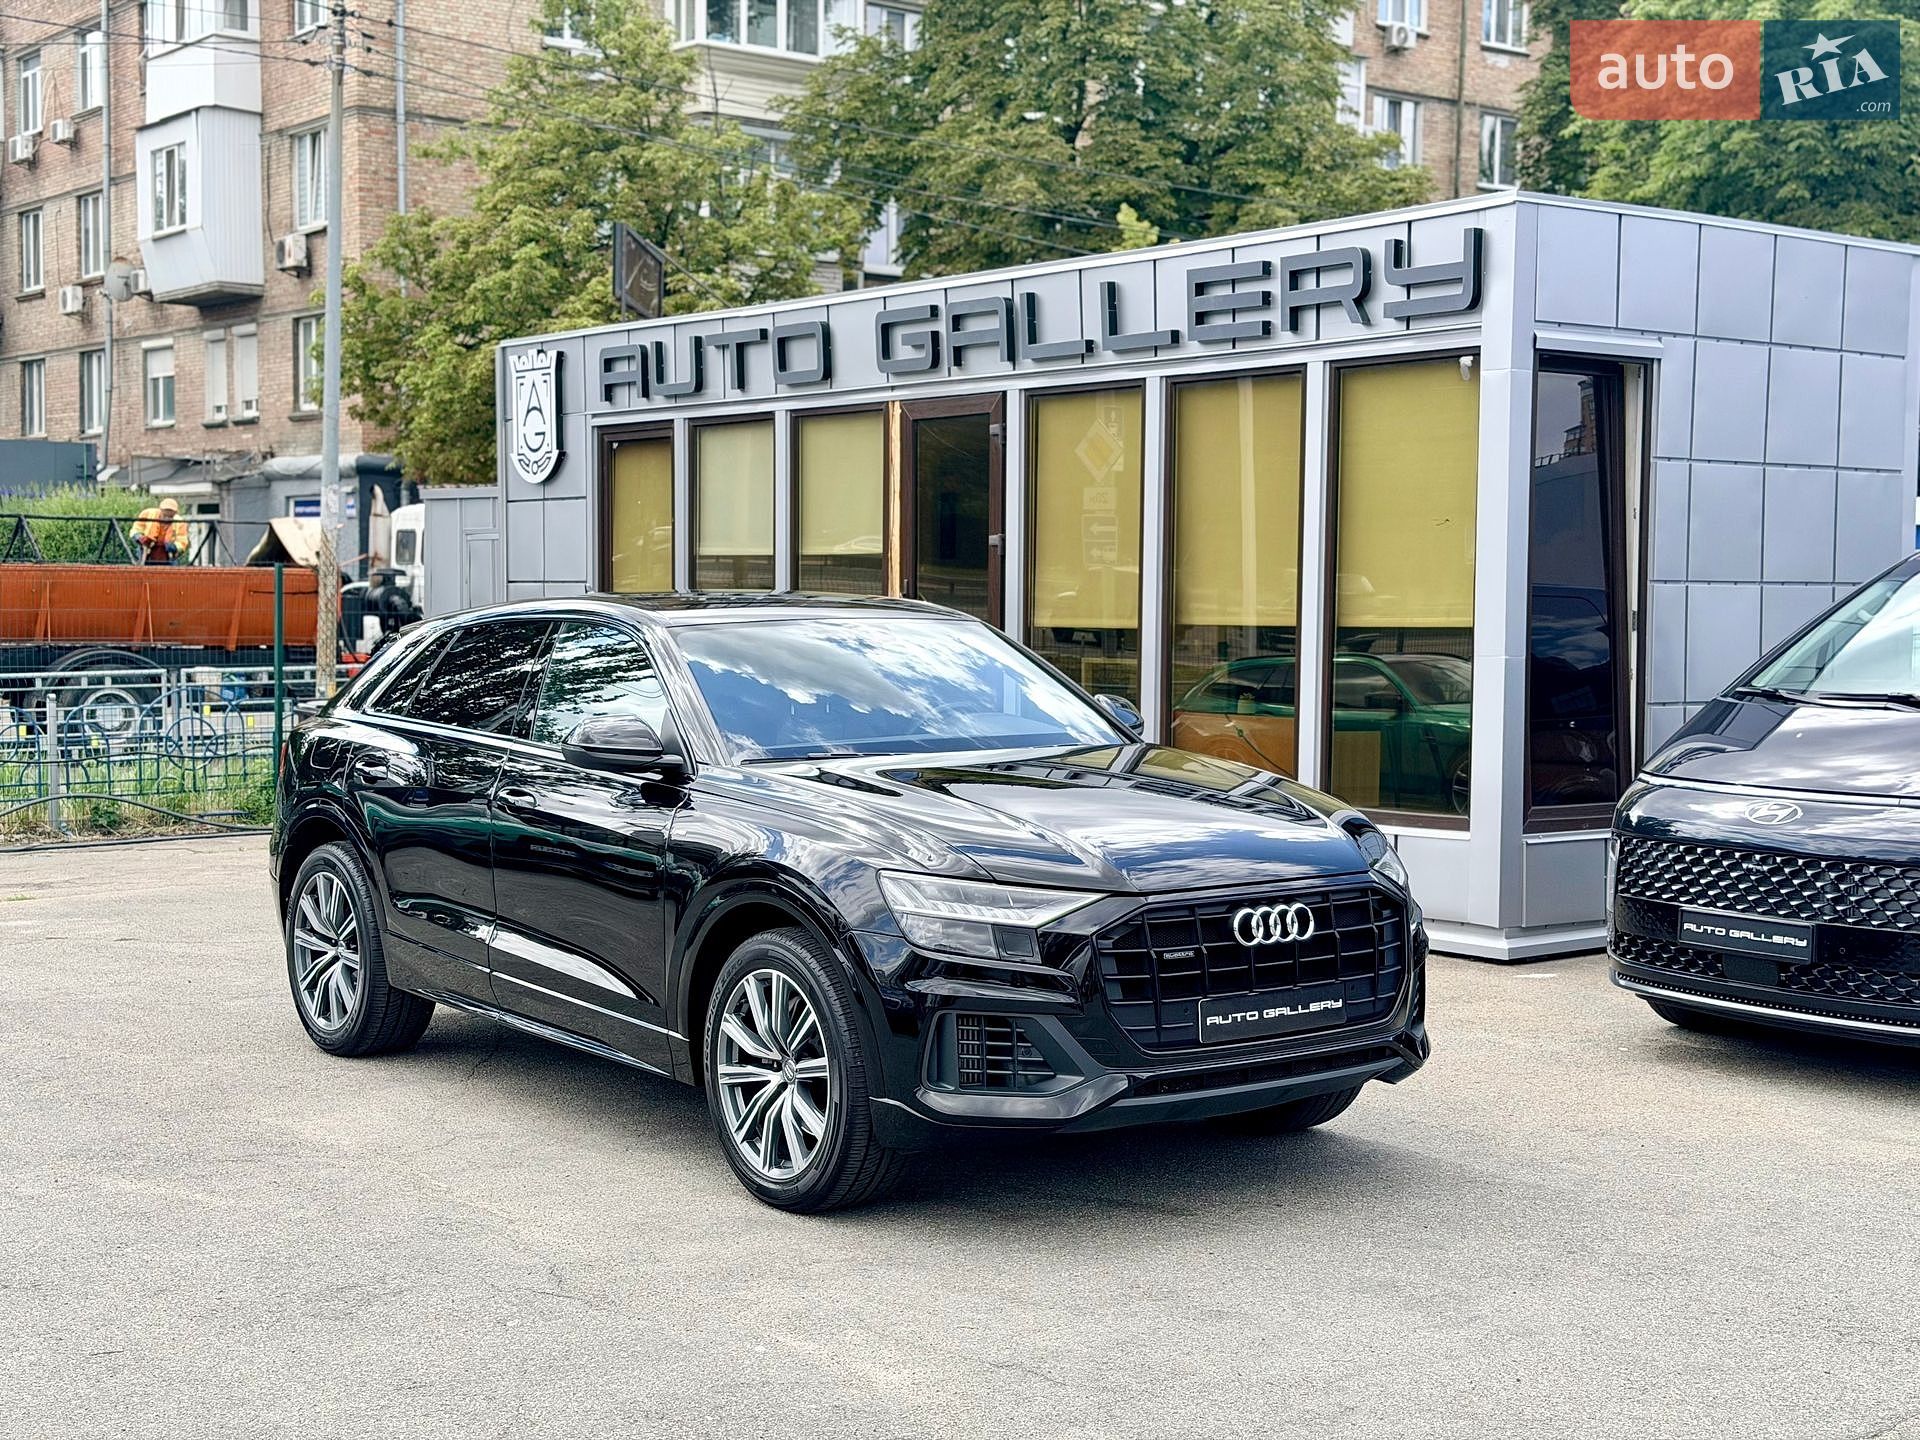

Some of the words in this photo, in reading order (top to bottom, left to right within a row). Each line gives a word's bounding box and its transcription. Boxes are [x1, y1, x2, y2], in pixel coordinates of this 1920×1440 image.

[600, 321, 832, 402] AUTO
[875, 227, 1484, 373] GALLERY
[1683, 922, 1726, 936] AUTO
[1729, 929, 1808, 947] GALLERY
[1206, 1011, 1259, 1026] AUTO
[1263, 999, 1343, 1019] GALLERY
